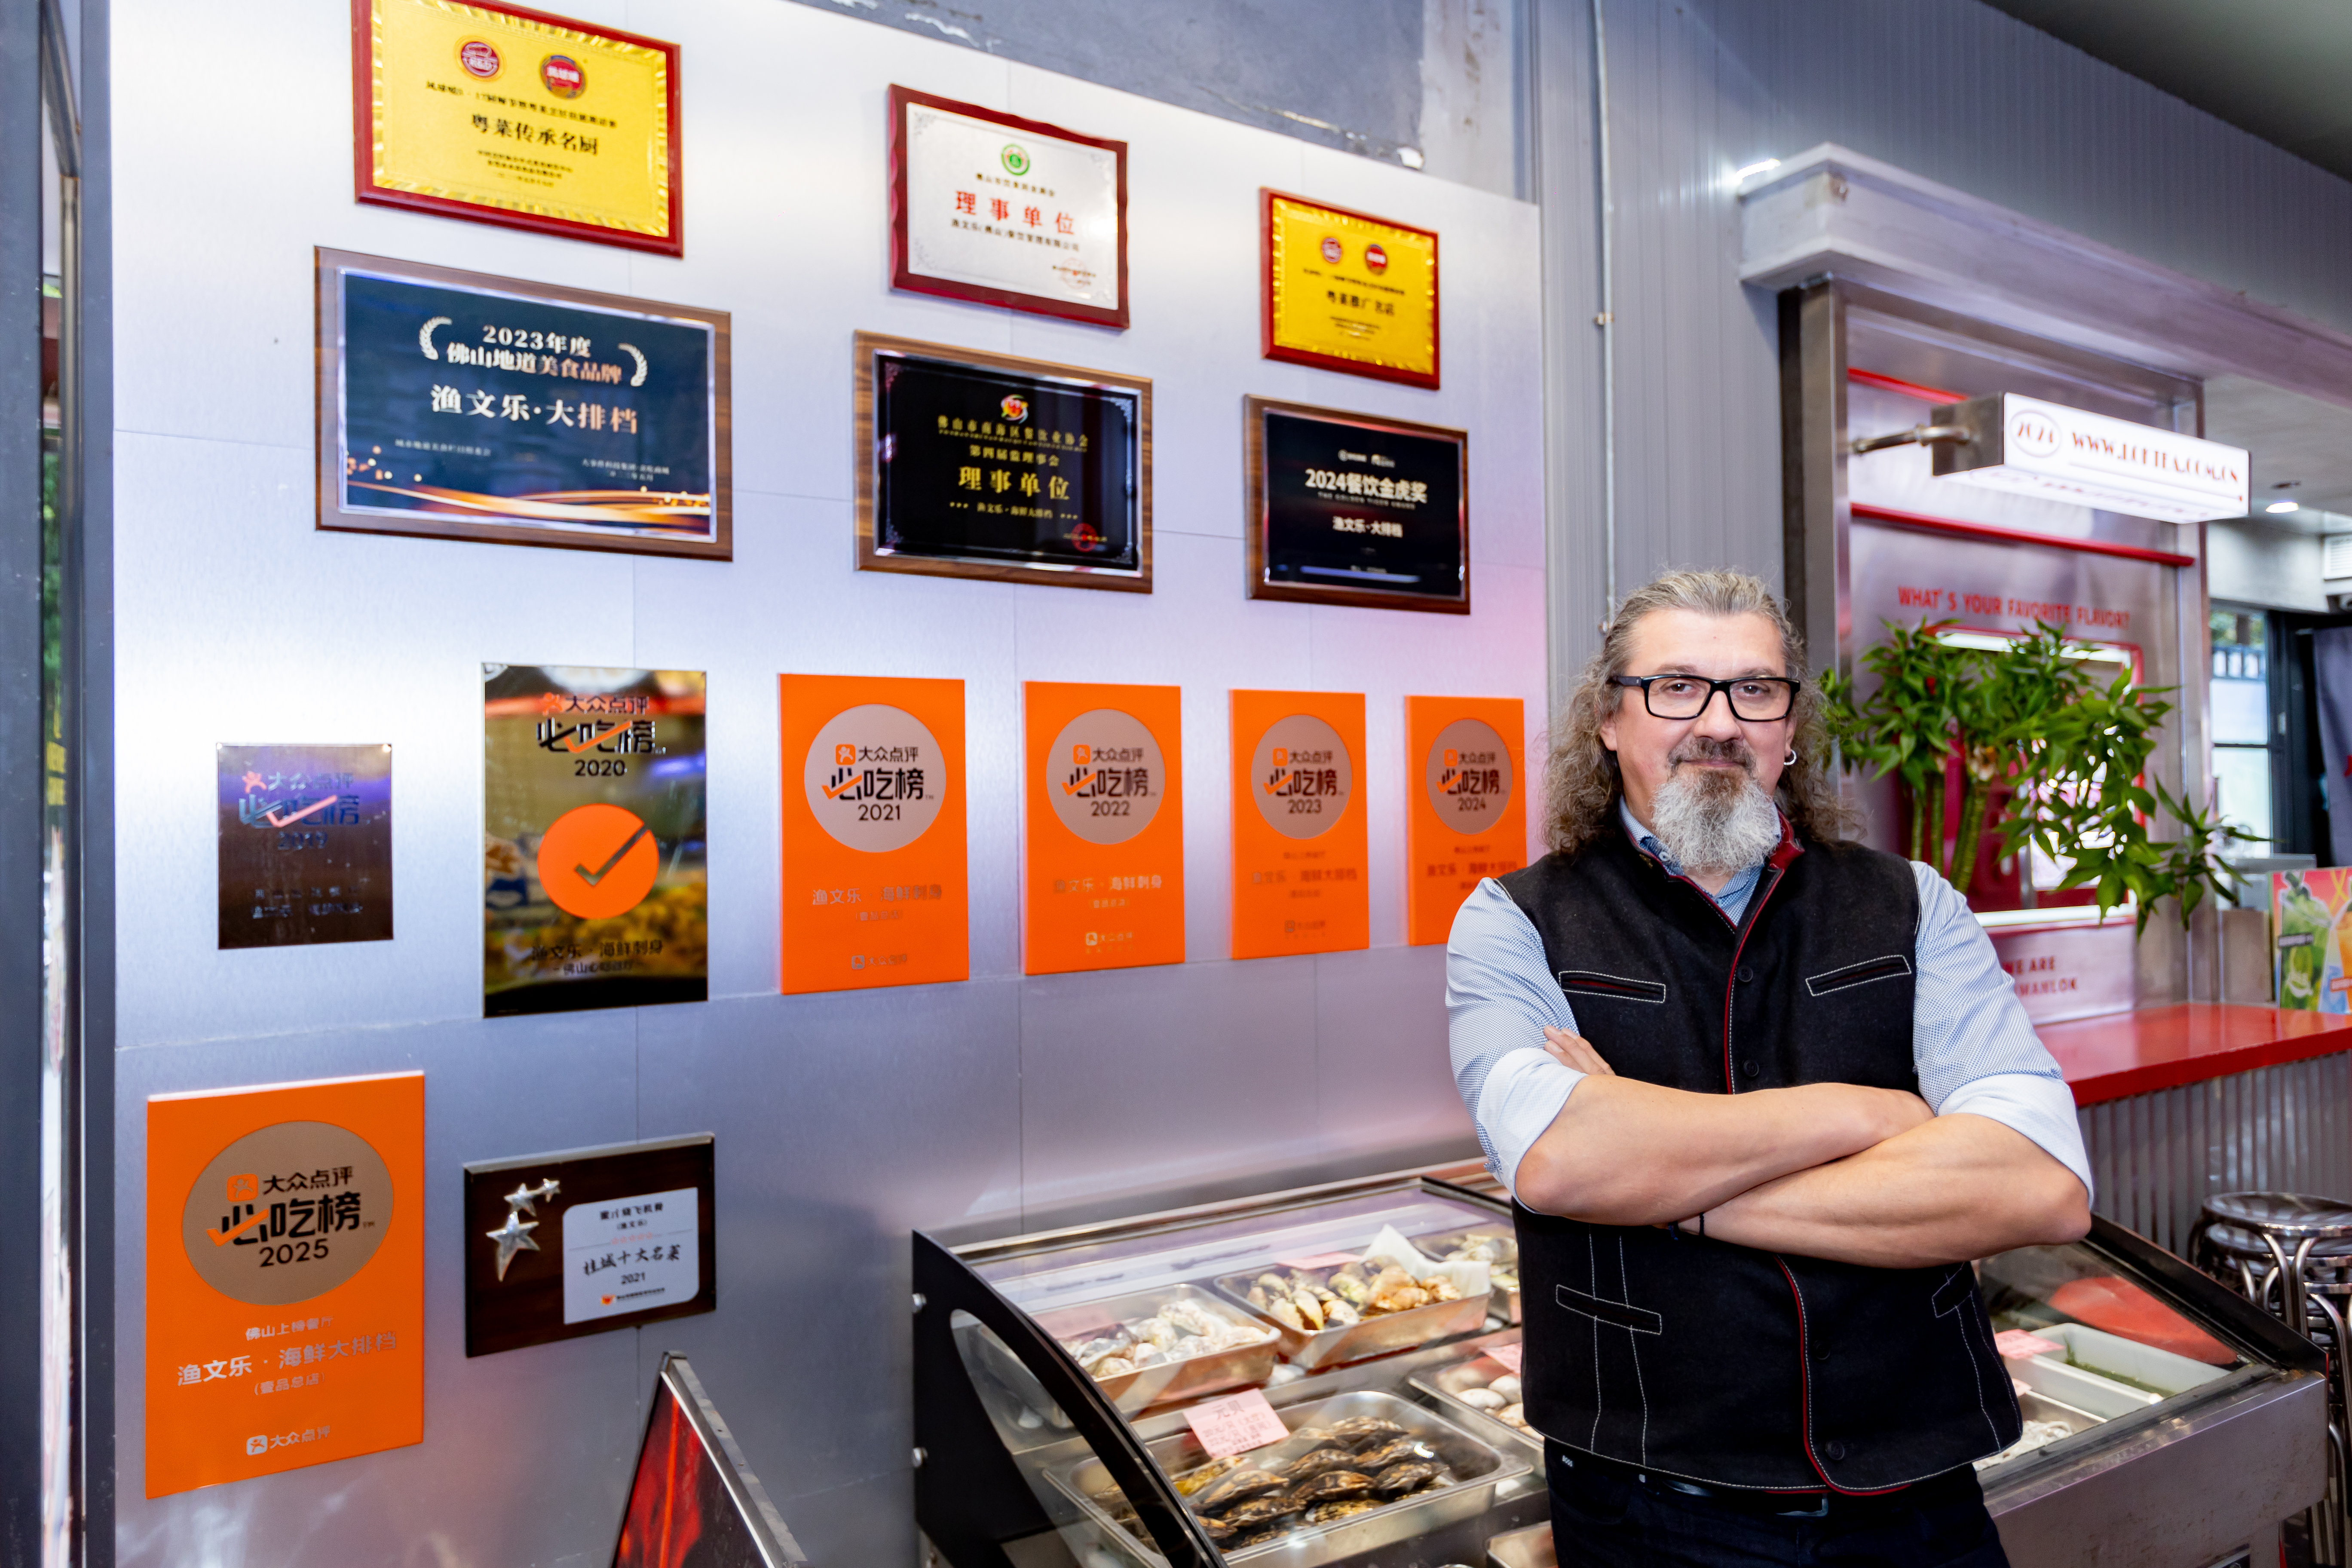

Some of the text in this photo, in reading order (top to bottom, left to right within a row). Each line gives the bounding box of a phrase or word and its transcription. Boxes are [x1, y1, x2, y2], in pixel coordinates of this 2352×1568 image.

[472, 114, 598, 156] 粤菜传承名厨
[956, 190, 1074, 235] 理事单位
[482, 325, 592, 358] 2023年度
[447, 341, 622, 385] 佛山地道美食品牌
[958, 466, 1070, 500] 理事单位
[1962, 593, 2002, 616] YOUR
[2007, 597, 2071, 624] FAVORITE
[565, 695, 649, 715] 大众点评
[536, 717, 655, 755] 必吃榜
[858, 745, 919, 763] 大众点评
[1092, 747, 1144, 763] 大众点评
[1289, 750, 1332, 765] 大众点评
[1458, 751, 1496, 765] 大众点评
[574, 759, 626, 777] 2020
[267, 772, 354, 791] 大众点评
[821, 767, 924, 801] 必吃榜
[1062, 766, 1148, 797] 必吃榜
[1263, 768, 1337, 796] 必吃榜
[1436, 769, 1500, 795] 必吃榜
[858, 804, 901, 822] 2021
[1091, 800, 1130, 817] 2022
[1287, 798, 1323, 814] 2023
[1458, 796, 1487, 812] 2024
[2002, 956, 2055, 975] WE ARE
[263, 1166, 353, 1195] 大众点评
[206, 1191, 361, 1246] 必吃榜
[259, 1238, 329, 1268] 2025
[621, 1272, 646, 1285] 2021
[270, 1425, 331, 1449] 大众点评
